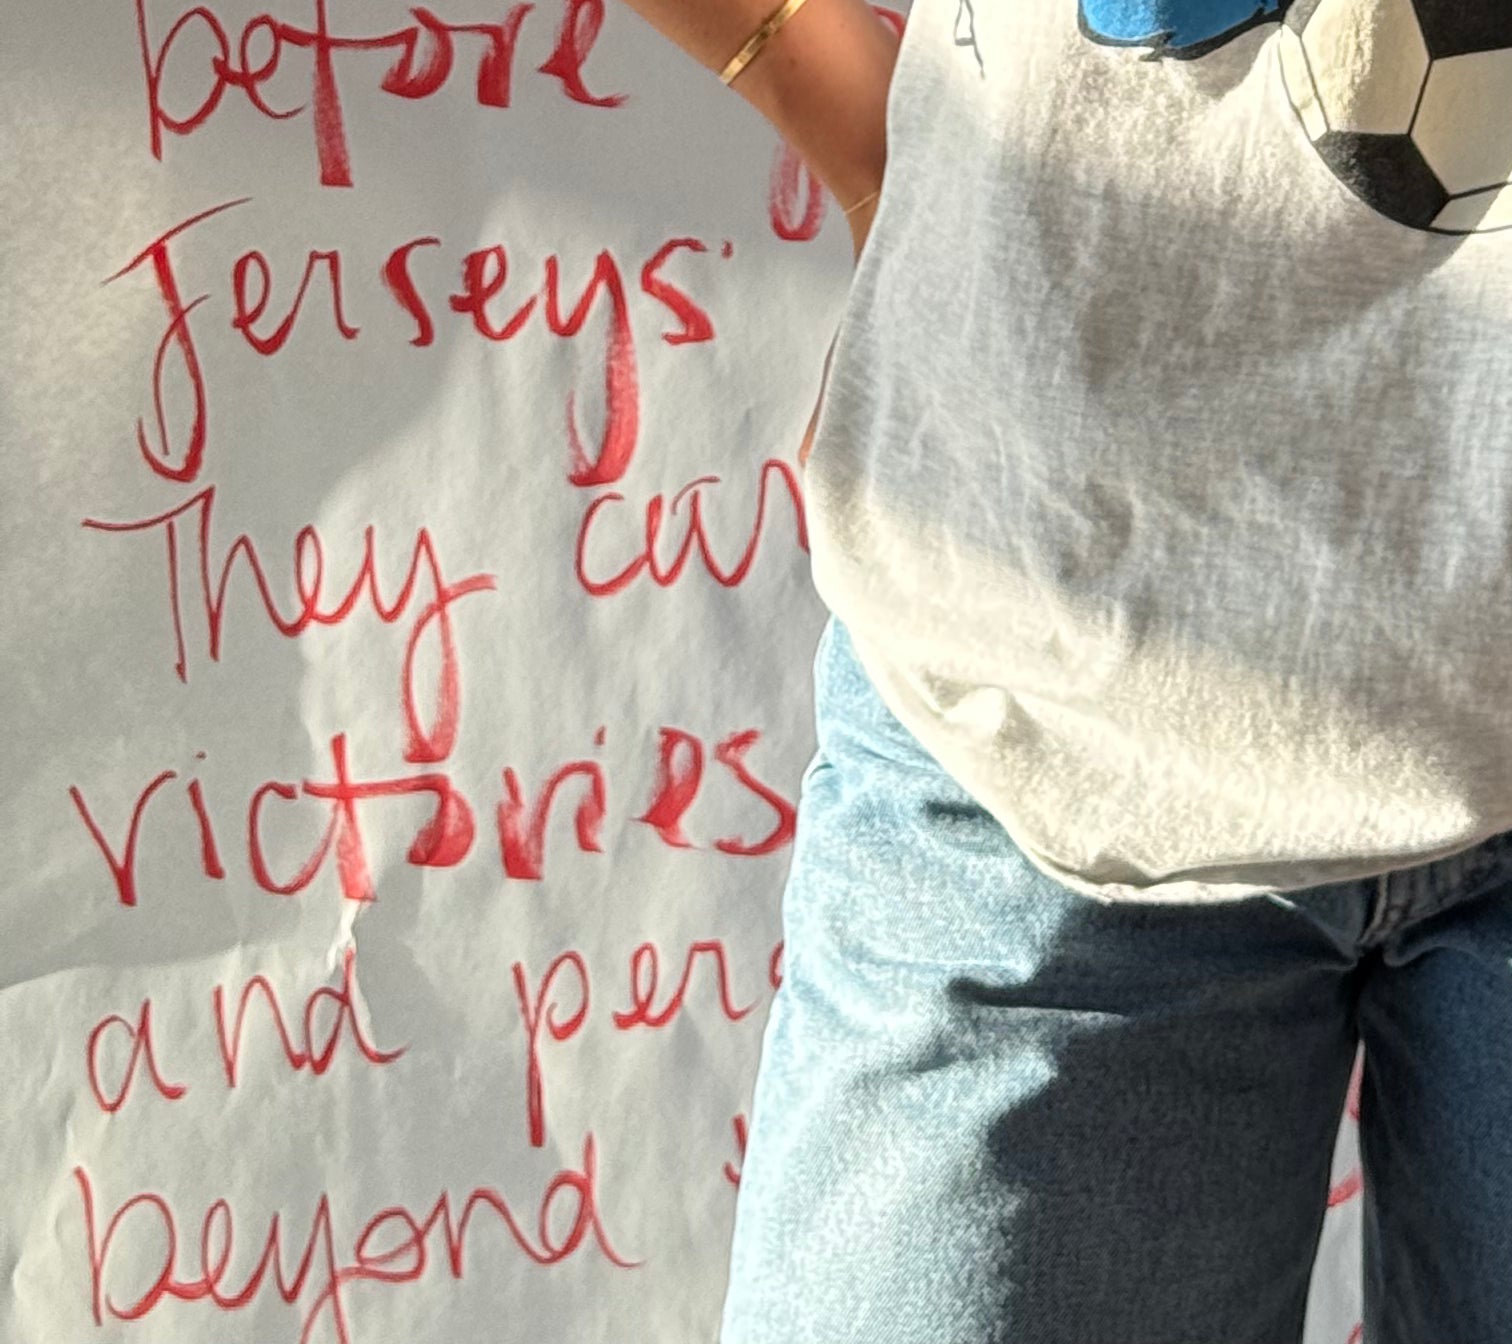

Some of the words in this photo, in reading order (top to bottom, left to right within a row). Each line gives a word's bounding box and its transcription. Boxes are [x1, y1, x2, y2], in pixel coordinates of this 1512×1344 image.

[82, 487, 497, 762] They
[85, 947, 412, 1112] and
[72, 1132, 648, 1344] beyond
